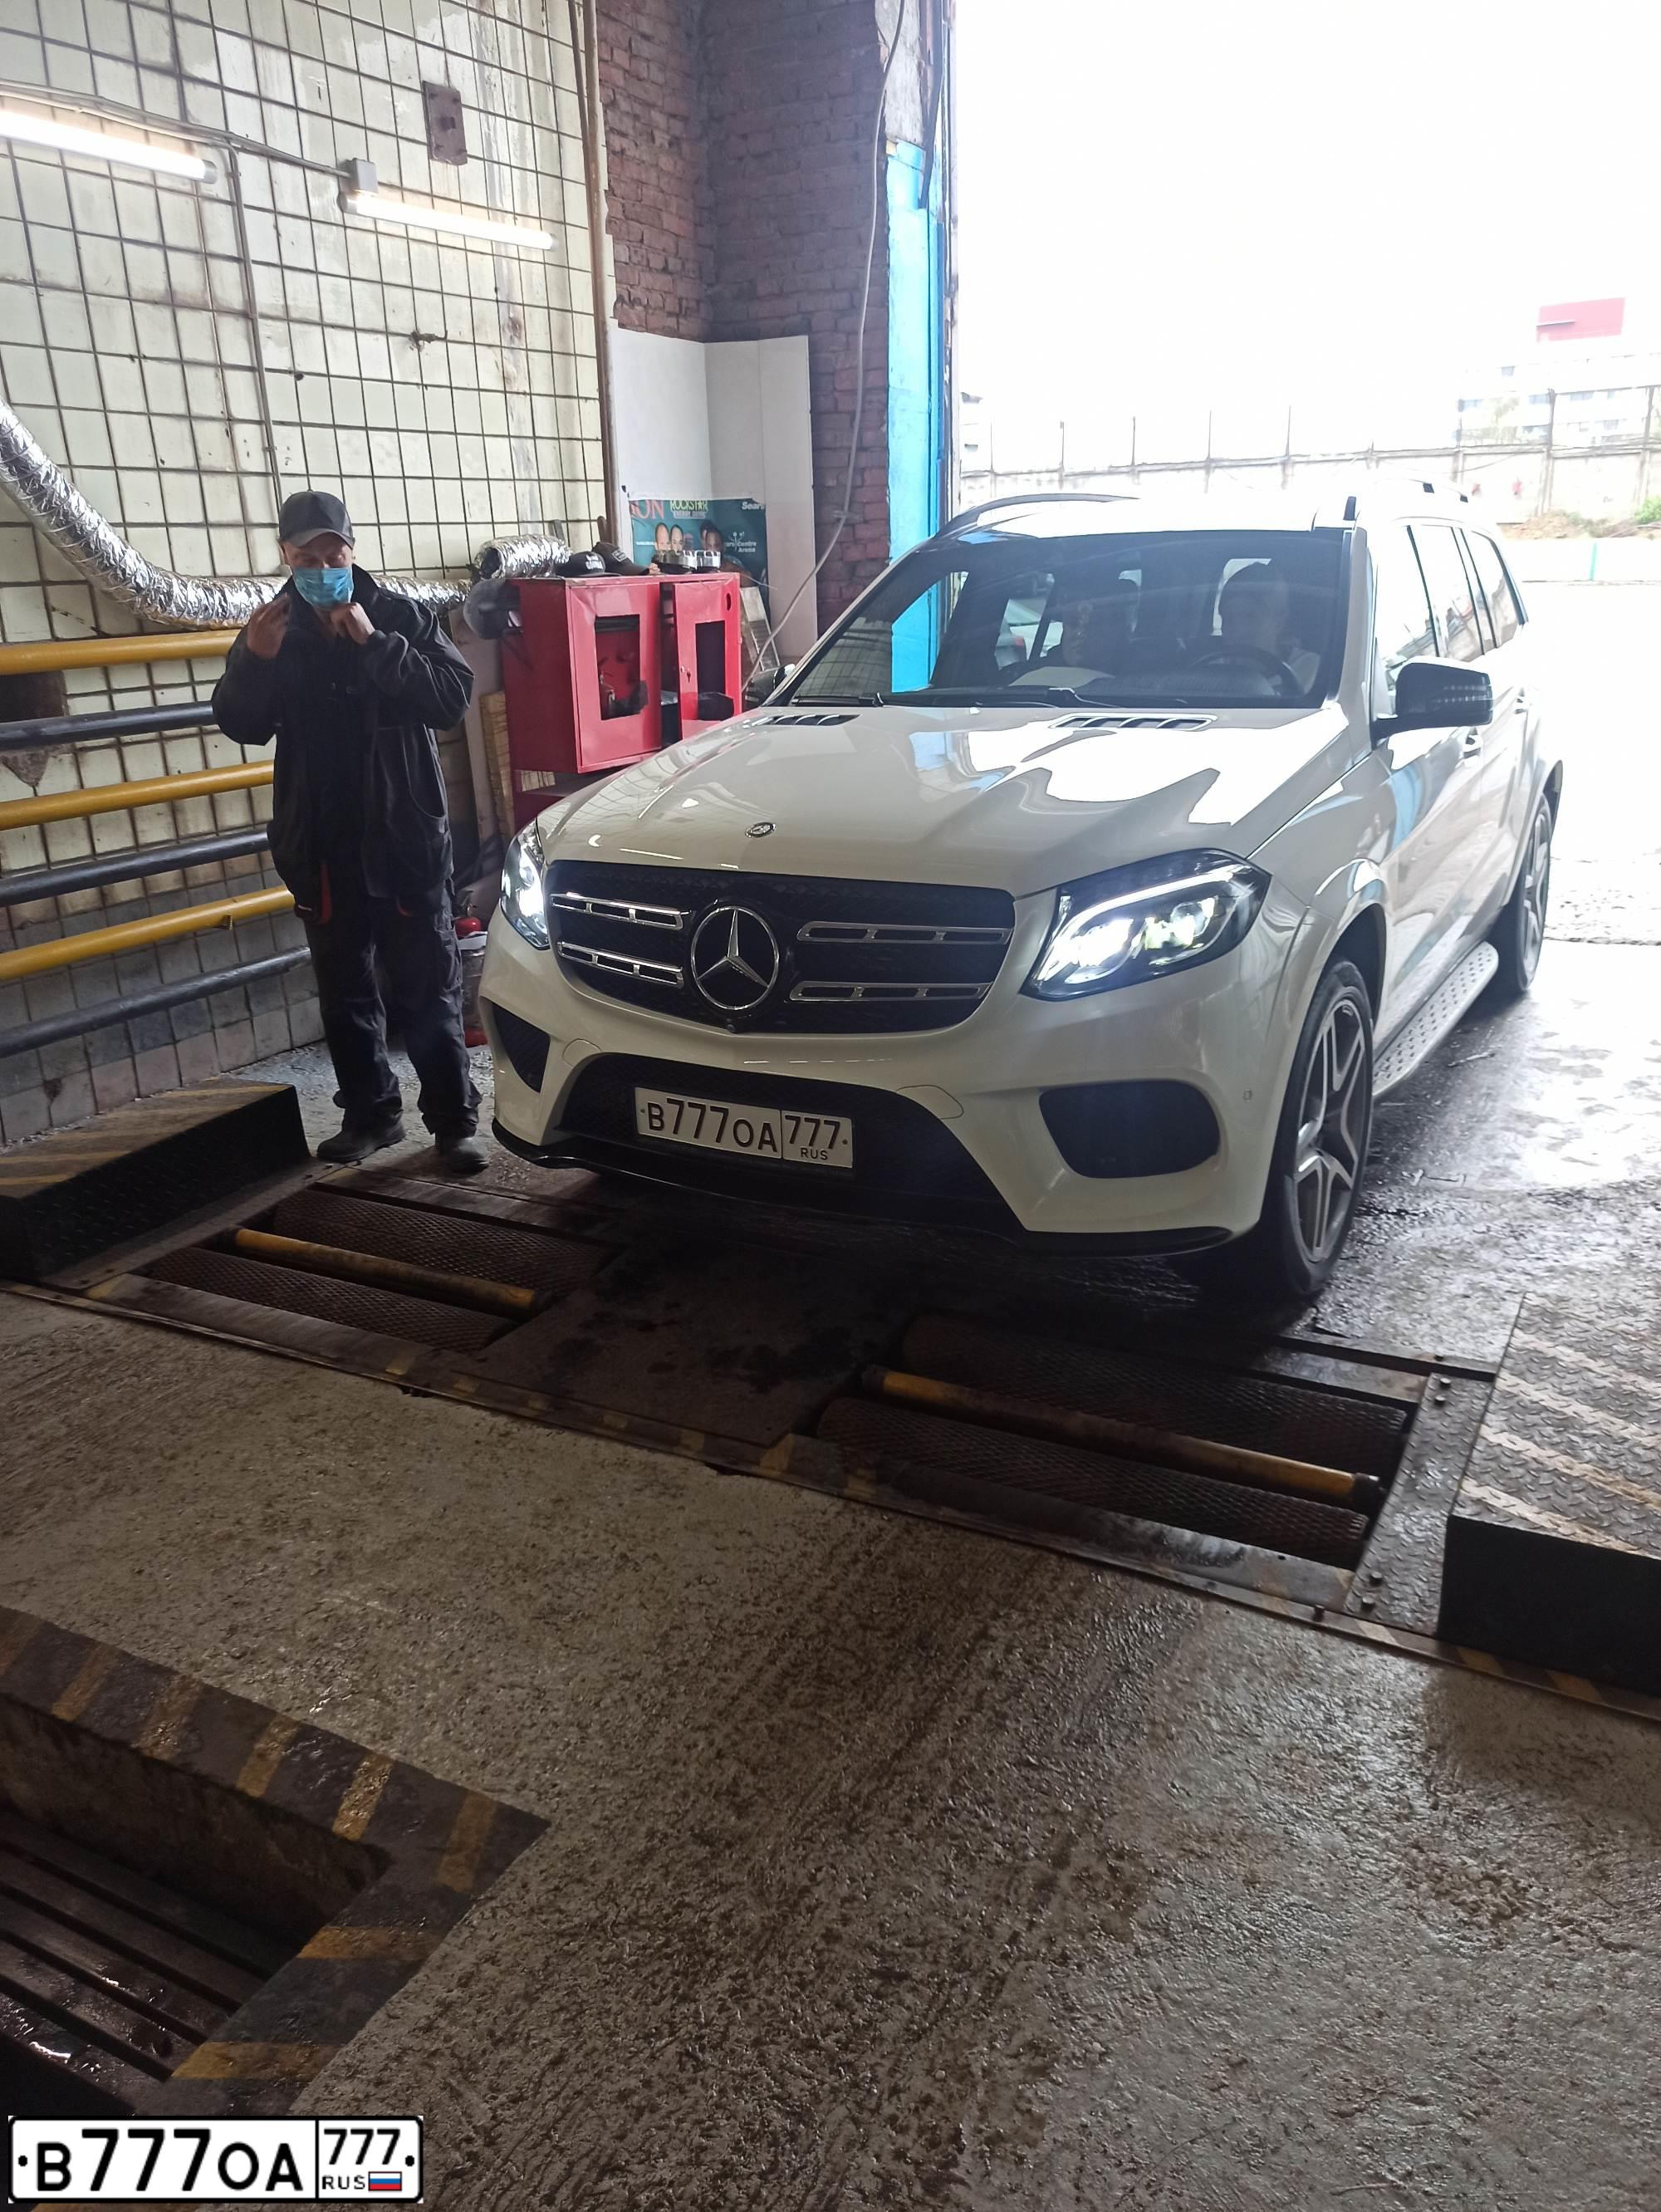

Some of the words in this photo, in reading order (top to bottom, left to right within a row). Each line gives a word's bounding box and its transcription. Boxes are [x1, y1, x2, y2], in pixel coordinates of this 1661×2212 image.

[647, 1097, 778, 1153] B777OA
[784, 1115, 840, 1150] 777
[800, 1147, 828, 1160] RUS
